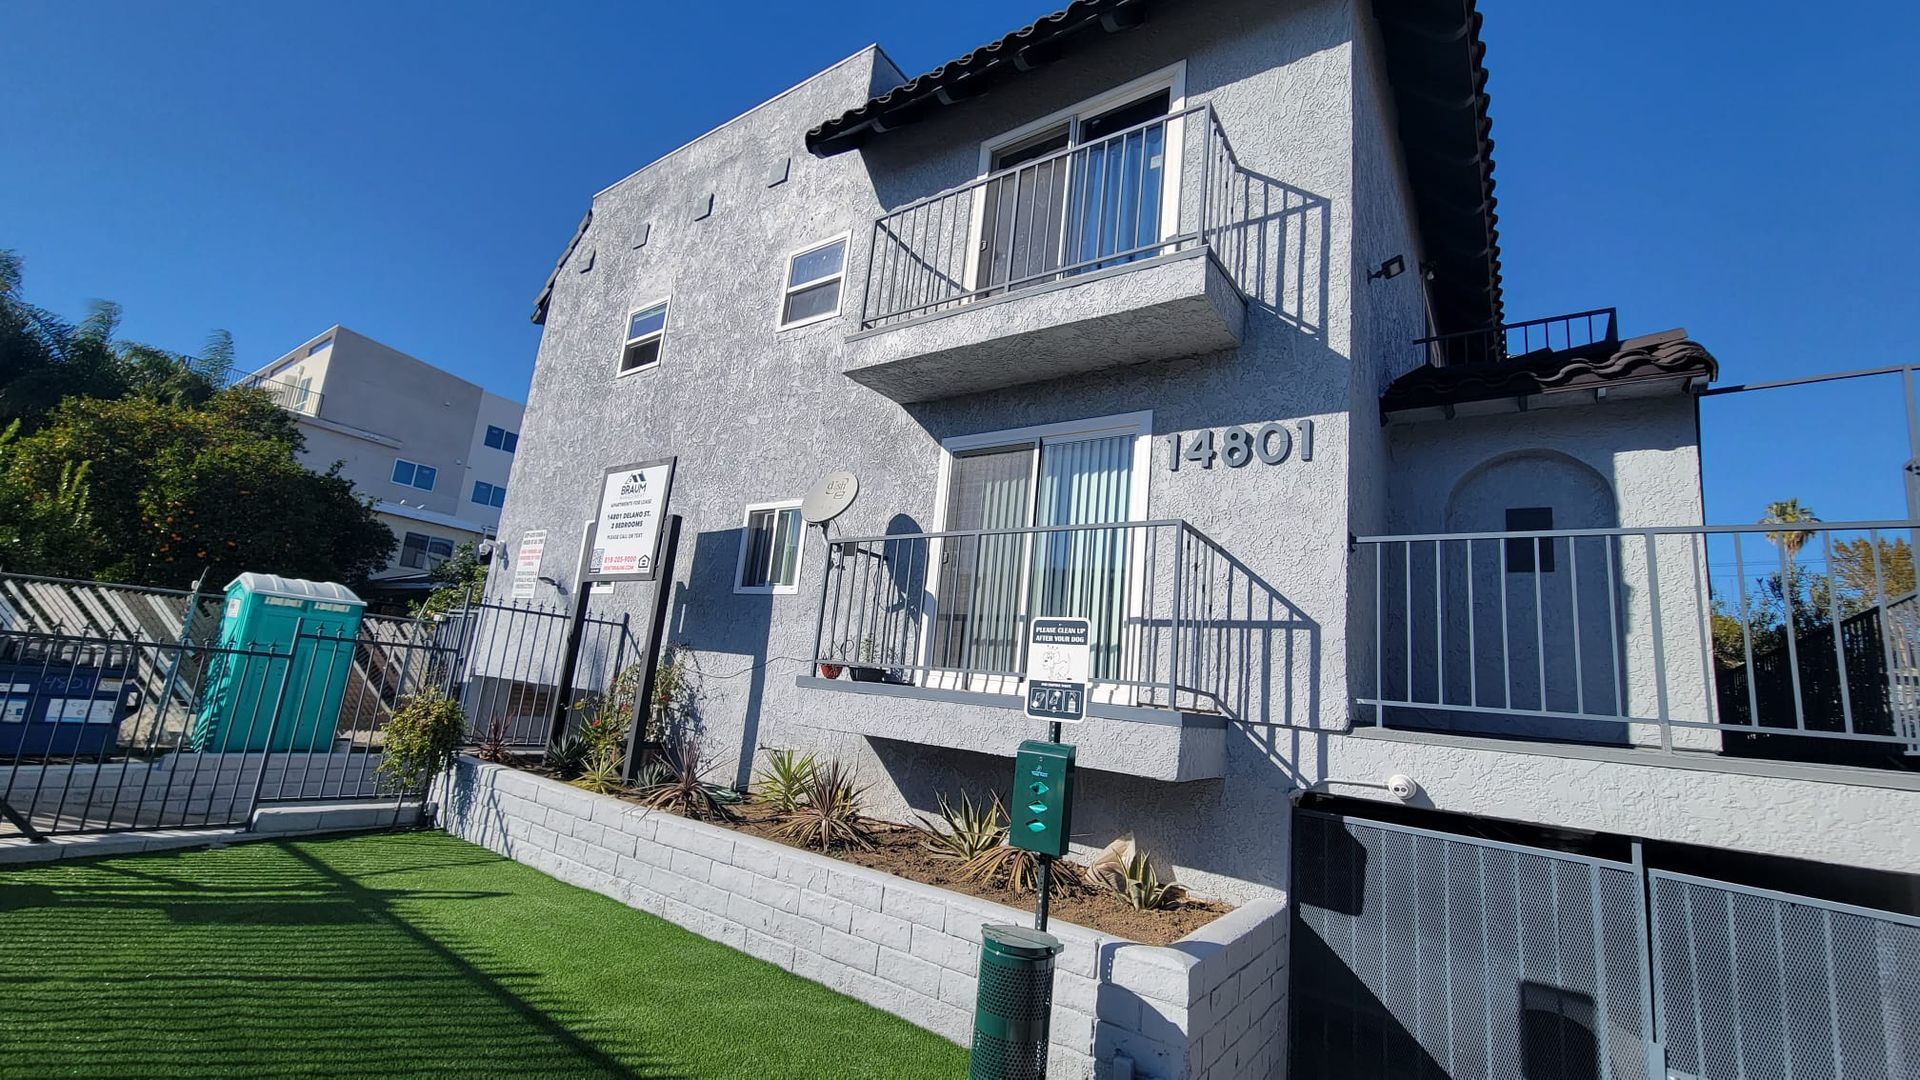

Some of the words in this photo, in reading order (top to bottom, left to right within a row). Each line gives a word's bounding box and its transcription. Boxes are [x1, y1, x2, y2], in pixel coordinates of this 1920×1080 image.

[1167, 419, 1314, 472] 14801
[620, 483, 647, 495] BRAUM
[623, 511, 644, 519] DELANO
[611, 522, 615, 530] 2
